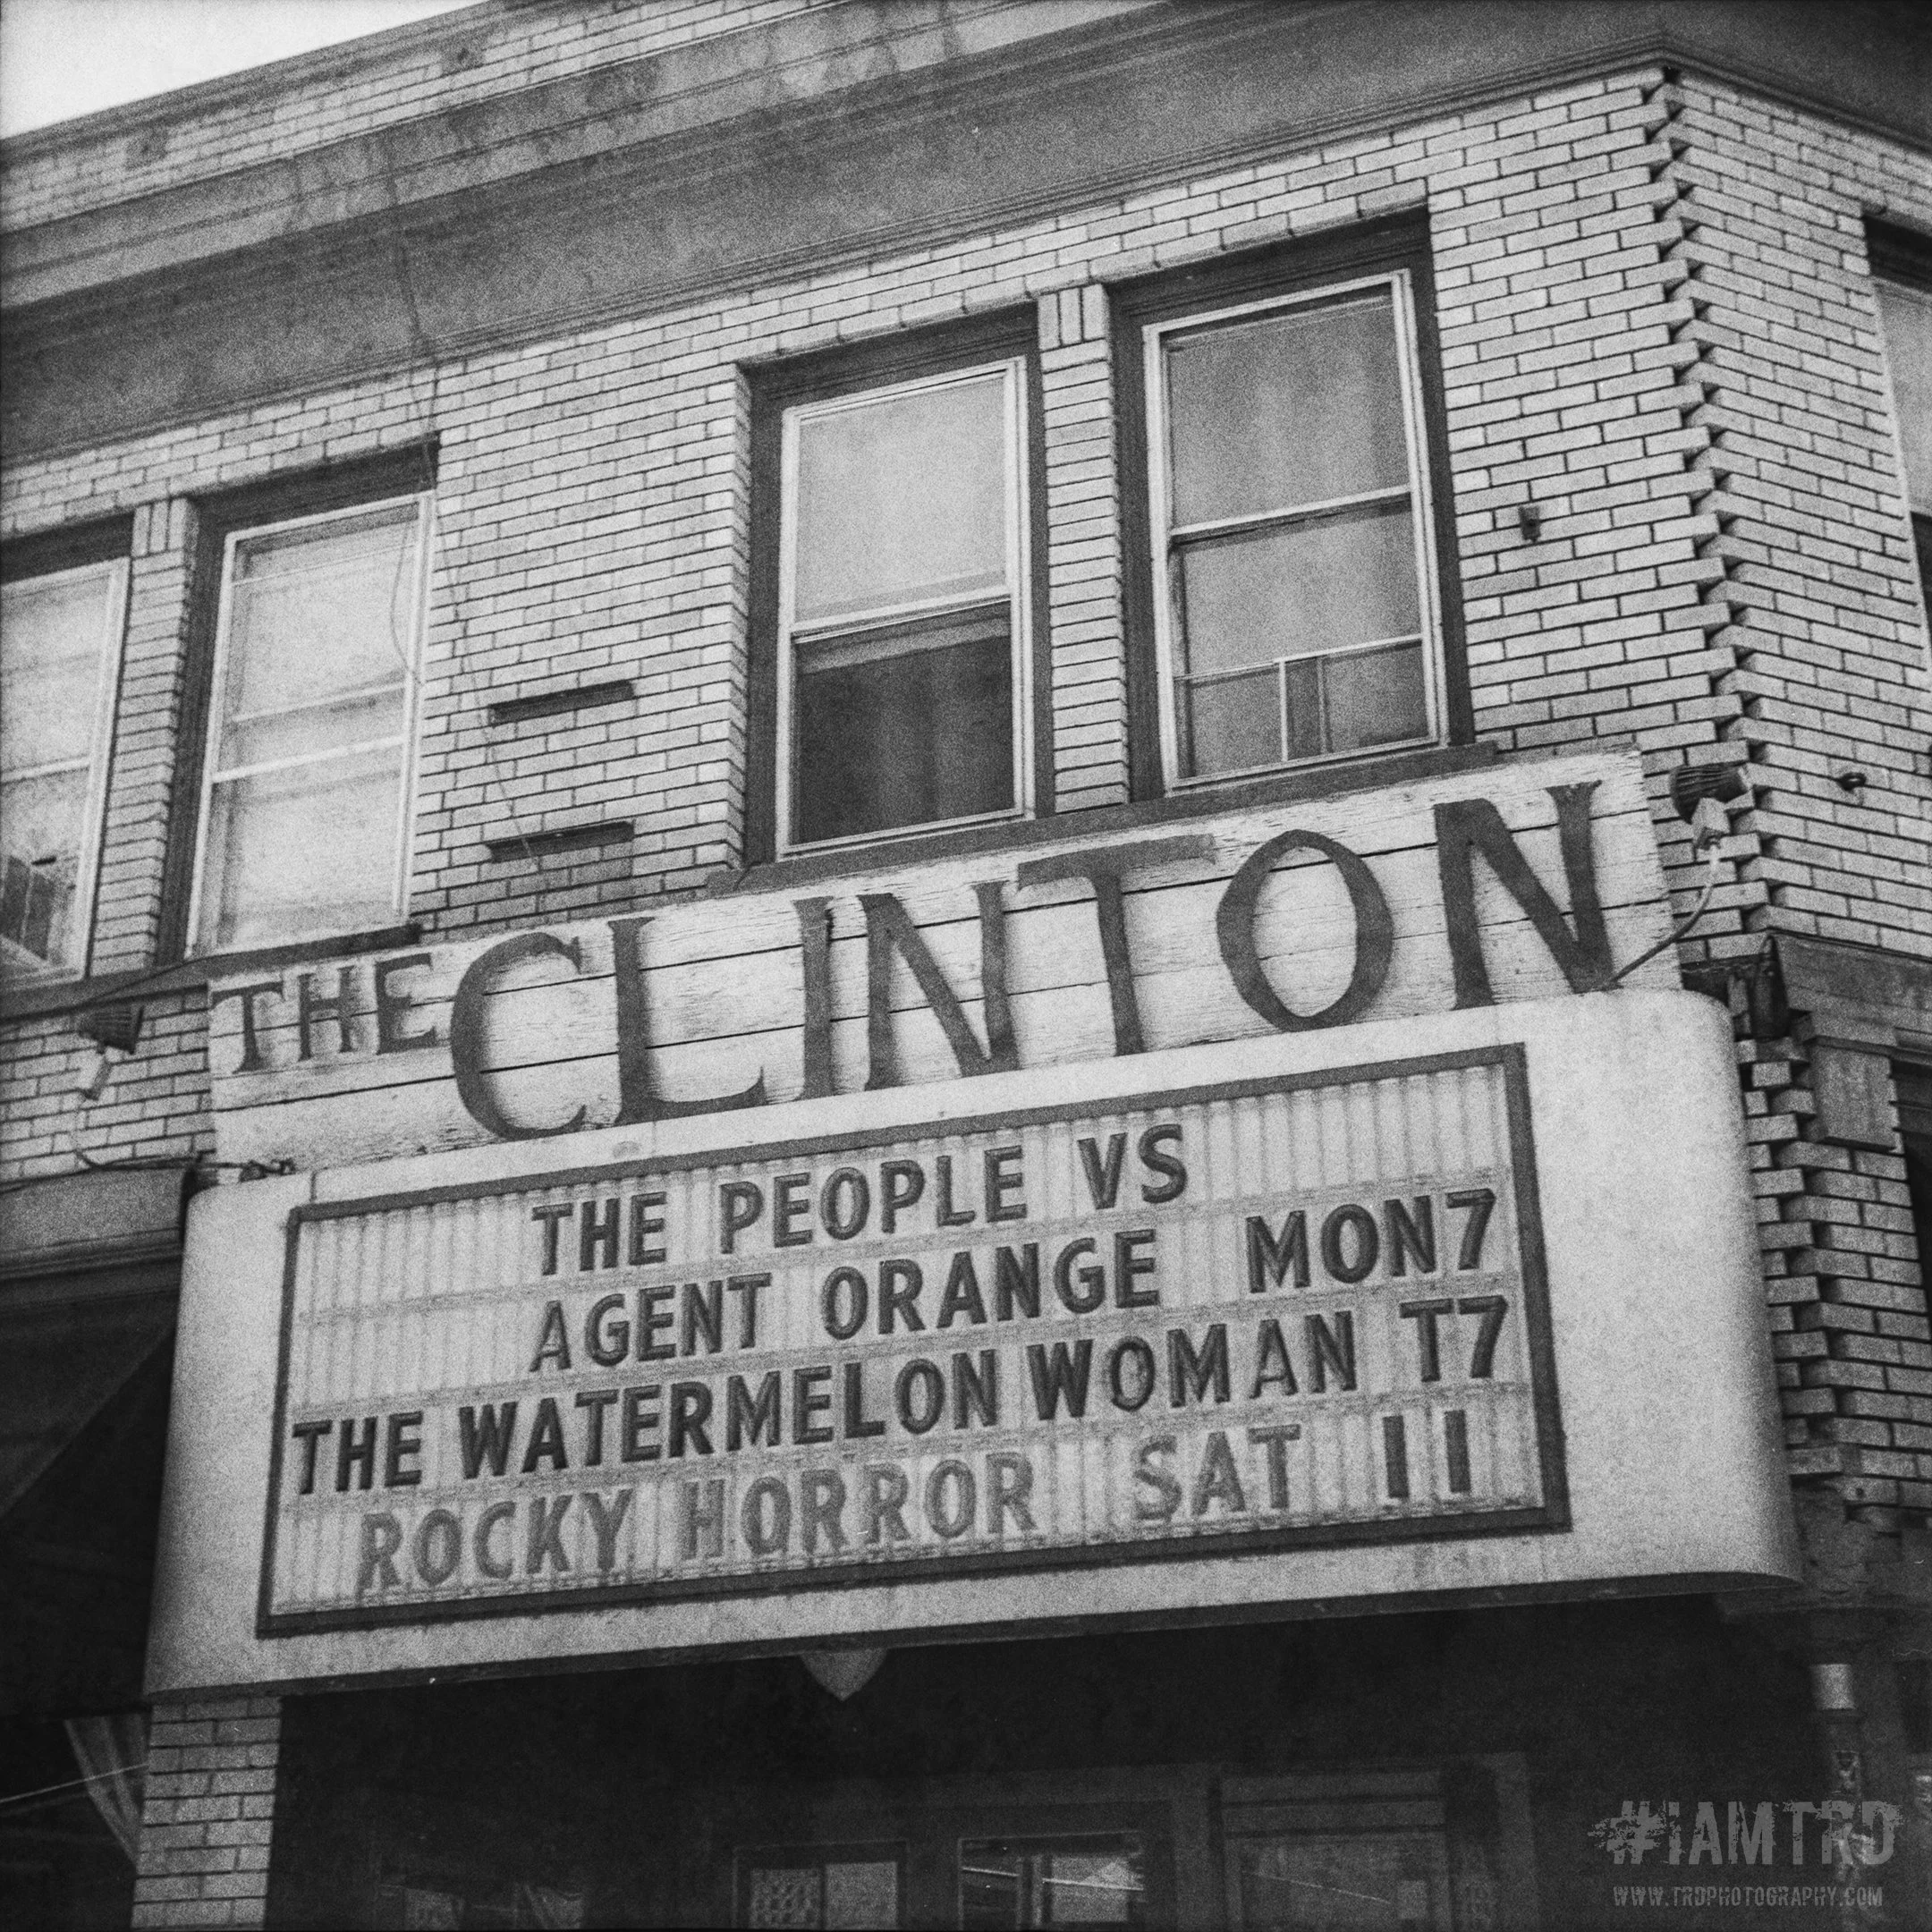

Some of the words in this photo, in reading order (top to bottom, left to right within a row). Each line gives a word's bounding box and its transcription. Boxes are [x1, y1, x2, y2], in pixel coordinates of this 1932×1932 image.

[210, 953, 444, 1073] THE
[450, 779, 1613, 1140] CLINTON
[531, 1191, 668, 1276] THE
[719, 1144, 1028, 1255] PEOPLE
[1079, 1123, 1189, 1210] VS
[528, 1272, 772, 1373] AGENT
[820, 1228, 1160, 1341] ORANGE
[292, 1411, 425, 1496] THE
[458, 1348, 1001, 1481] WATERMELON
[1027, 1310, 1358, 1420] WOMAN
[360, 1488, 634, 1590] ROCKY
[679, 1451, 1038, 1562] HORROR
[1133, 1423, 1301, 1524] SAT
